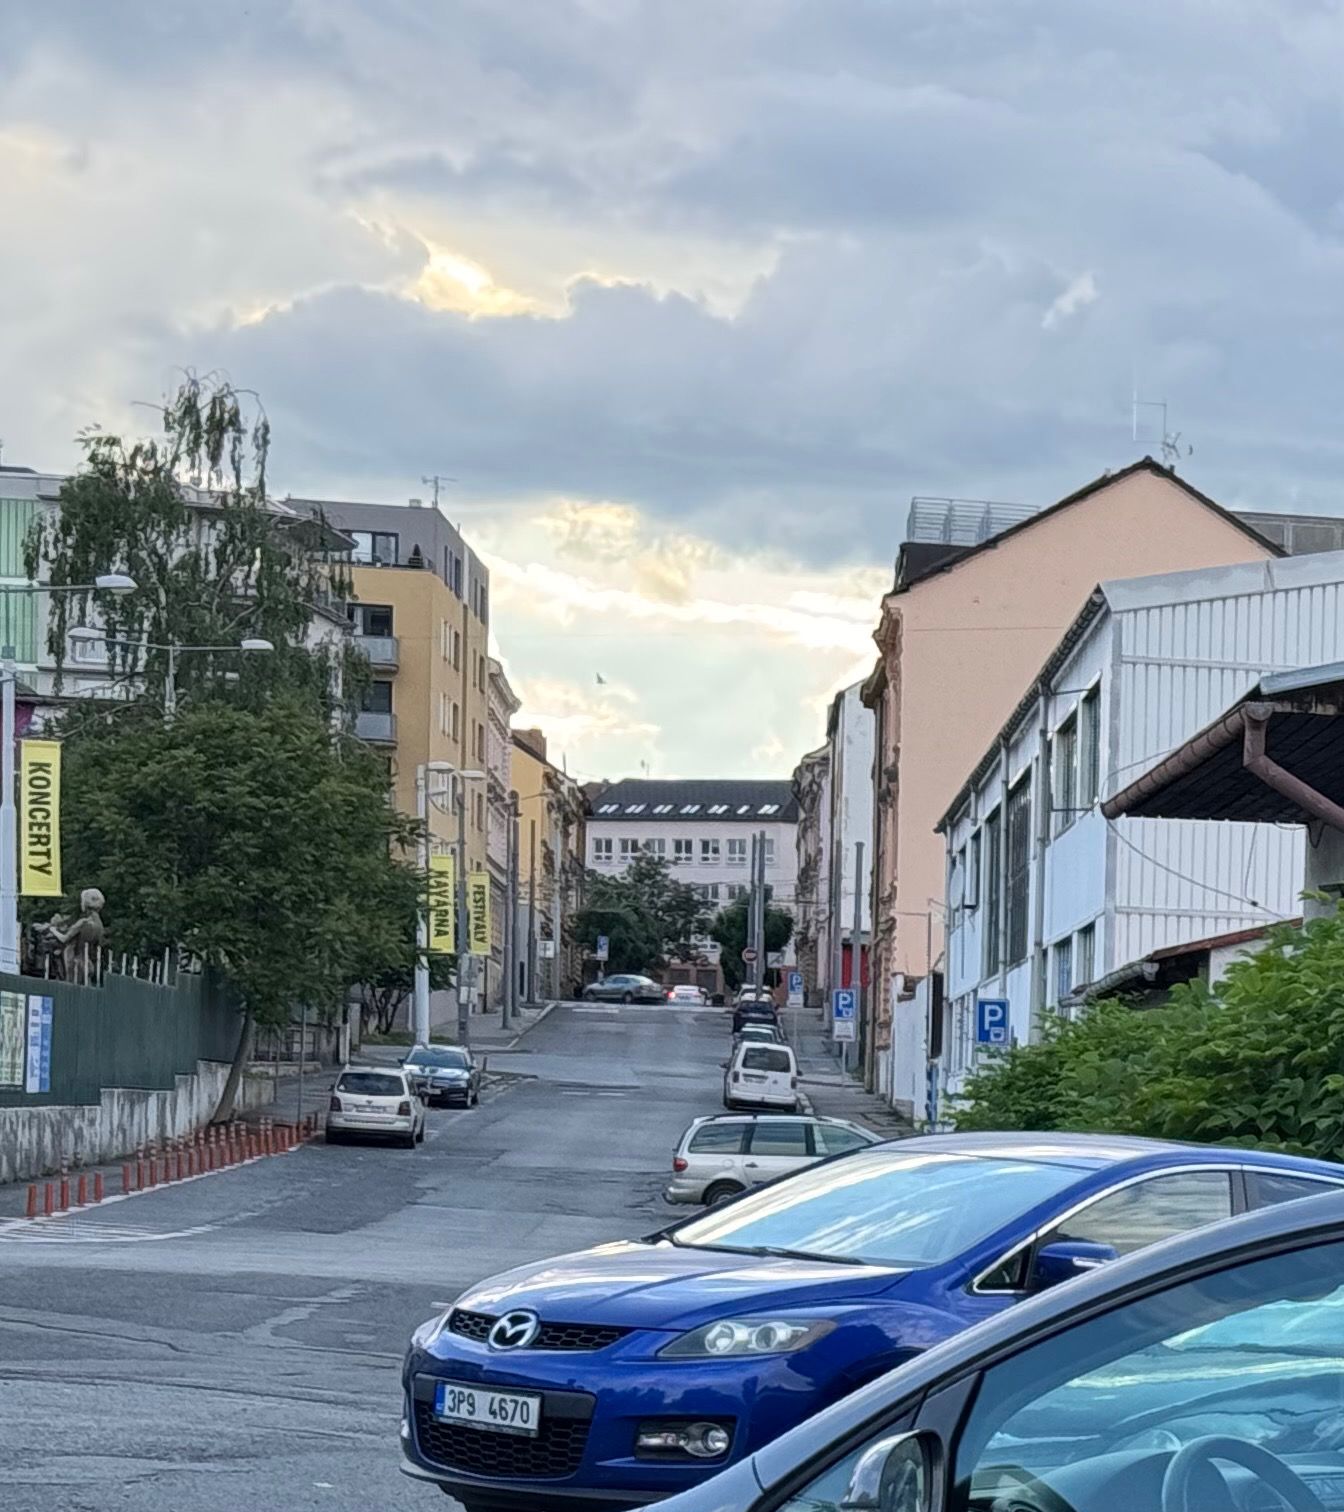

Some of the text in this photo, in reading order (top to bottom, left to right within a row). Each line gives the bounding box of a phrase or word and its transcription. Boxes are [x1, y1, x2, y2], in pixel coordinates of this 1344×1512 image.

[28, 762, 52, 876] KONCERTY
[984, 1004, 1003, 1031] P
[448, 1389, 530, 1424] 3P9 4670
